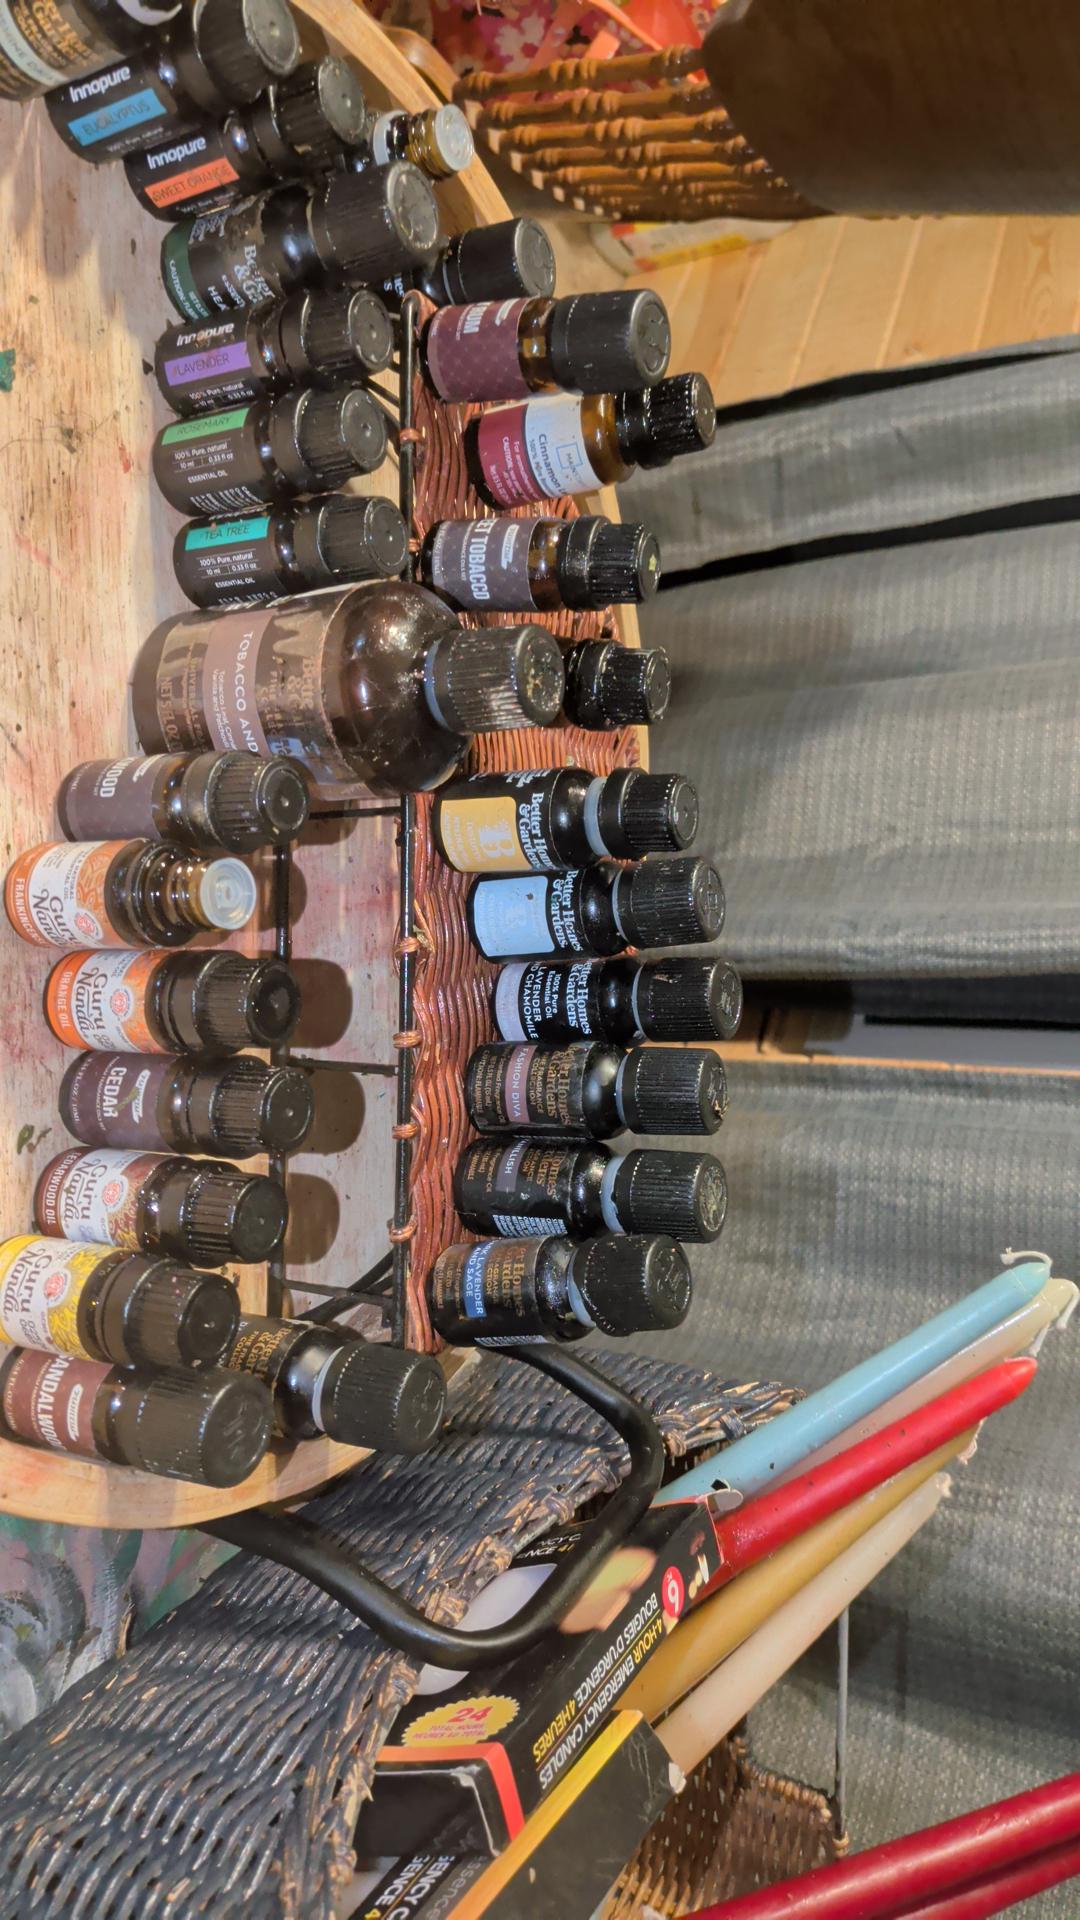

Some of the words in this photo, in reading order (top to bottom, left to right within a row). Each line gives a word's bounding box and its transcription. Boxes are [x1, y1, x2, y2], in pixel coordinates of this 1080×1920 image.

[69, 66, 131, 103] Innopure
[146, 136, 207, 170] Innopure
[243, 245, 276, 298] Beter
[176, 322, 235, 347] Innopure
[176, 353, 230, 377] LAVENDER
[206, 441, 229, 454] natural
[537, 433, 562, 489] Cinnamon
[205, 529, 223, 541] TEA
[226, 523, 251, 537] TREE
[199, 556, 217, 567] 100%
[232, 551, 254, 562] natural
[468, 535, 491, 600] TOBACCO
[214, 578, 245, 589] ESSENTIAL
[217, 670, 226, 705] Tobacco
[234, 630, 254, 712] TOBACCO
[212, 695, 220, 712] and
[215, 713, 230, 749] Patchouli
[238, 718, 259, 753] AND
[518, 803, 531, 818] &
[530, 792, 545, 838] Better
[552, 878, 566, 891] &
[561, 869, 580, 909] Better
[48, 895, 82, 946] Guru
[550, 890, 569, 949] Gardens
[562, 910, 584, 952] Homes
[544, 970, 555, 1004] Essential
[552, 973, 562, 993] 100%
[570, 963, 582, 975] &
[577, 961, 594, 988] etter
[57, 971, 74, 1012] ORANGE
[75, 967, 100, 1034] Nanda
[91, 973, 109, 1030] Guru
[522, 973, 539, 1039] CHAMOMILE
[531, 966, 548, 1022] LAVENDER
[551, 994, 559, 1014] Pure
[566, 972, 579, 1029] Gardens
[576, 988, 593, 1035] Homes
[58, 1013, 71, 1030] OIL
[544, 1006, 553, 1019] Oil
[511, 1047, 529, 1090] FASHION
[102, 1066, 128, 1118] CEDAR
[511, 1092, 521, 1118] DIVA
[535, 1066, 545, 1114] FRAGRANCE
[545, 1060, 560, 1119] Gardens
[557, 1079, 572, 1125] Homes
[45, 1152, 82, 1207] CEDARWOOD
[62, 1158, 102, 1223] Nanda
[80, 1164, 108, 1221] Guru
[44, 1208, 57, 1226] OIL
[468, 1246, 481, 1266] AND
[1, 1247, 47, 1319] Nanda
[20, 1253, 54, 1314] Guru
[464, 1268, 475, 1298] SAGE
[473, 1256, 486, 1315] LAVENDER
[243, 1330, 259, 1346] FINE
[257, 1331, 272, 1343] &
[261, 1327, 292, 1359] Better
[36, 1355, 75, 1451] SANDALWOO
[667, 1579, 680, 1615] 6
[622, 1592, 658, 1645] BOUGIES
[632, 1617, 664, 1664] 4-HOUR
[572, 1635, 624, 1709] D'URGENCE
[447, 1705, 494, 1723] 24
[582, 1654, 635, 1734] EMERGENCY
[539, 1724, 584, 1790] CANDLES
